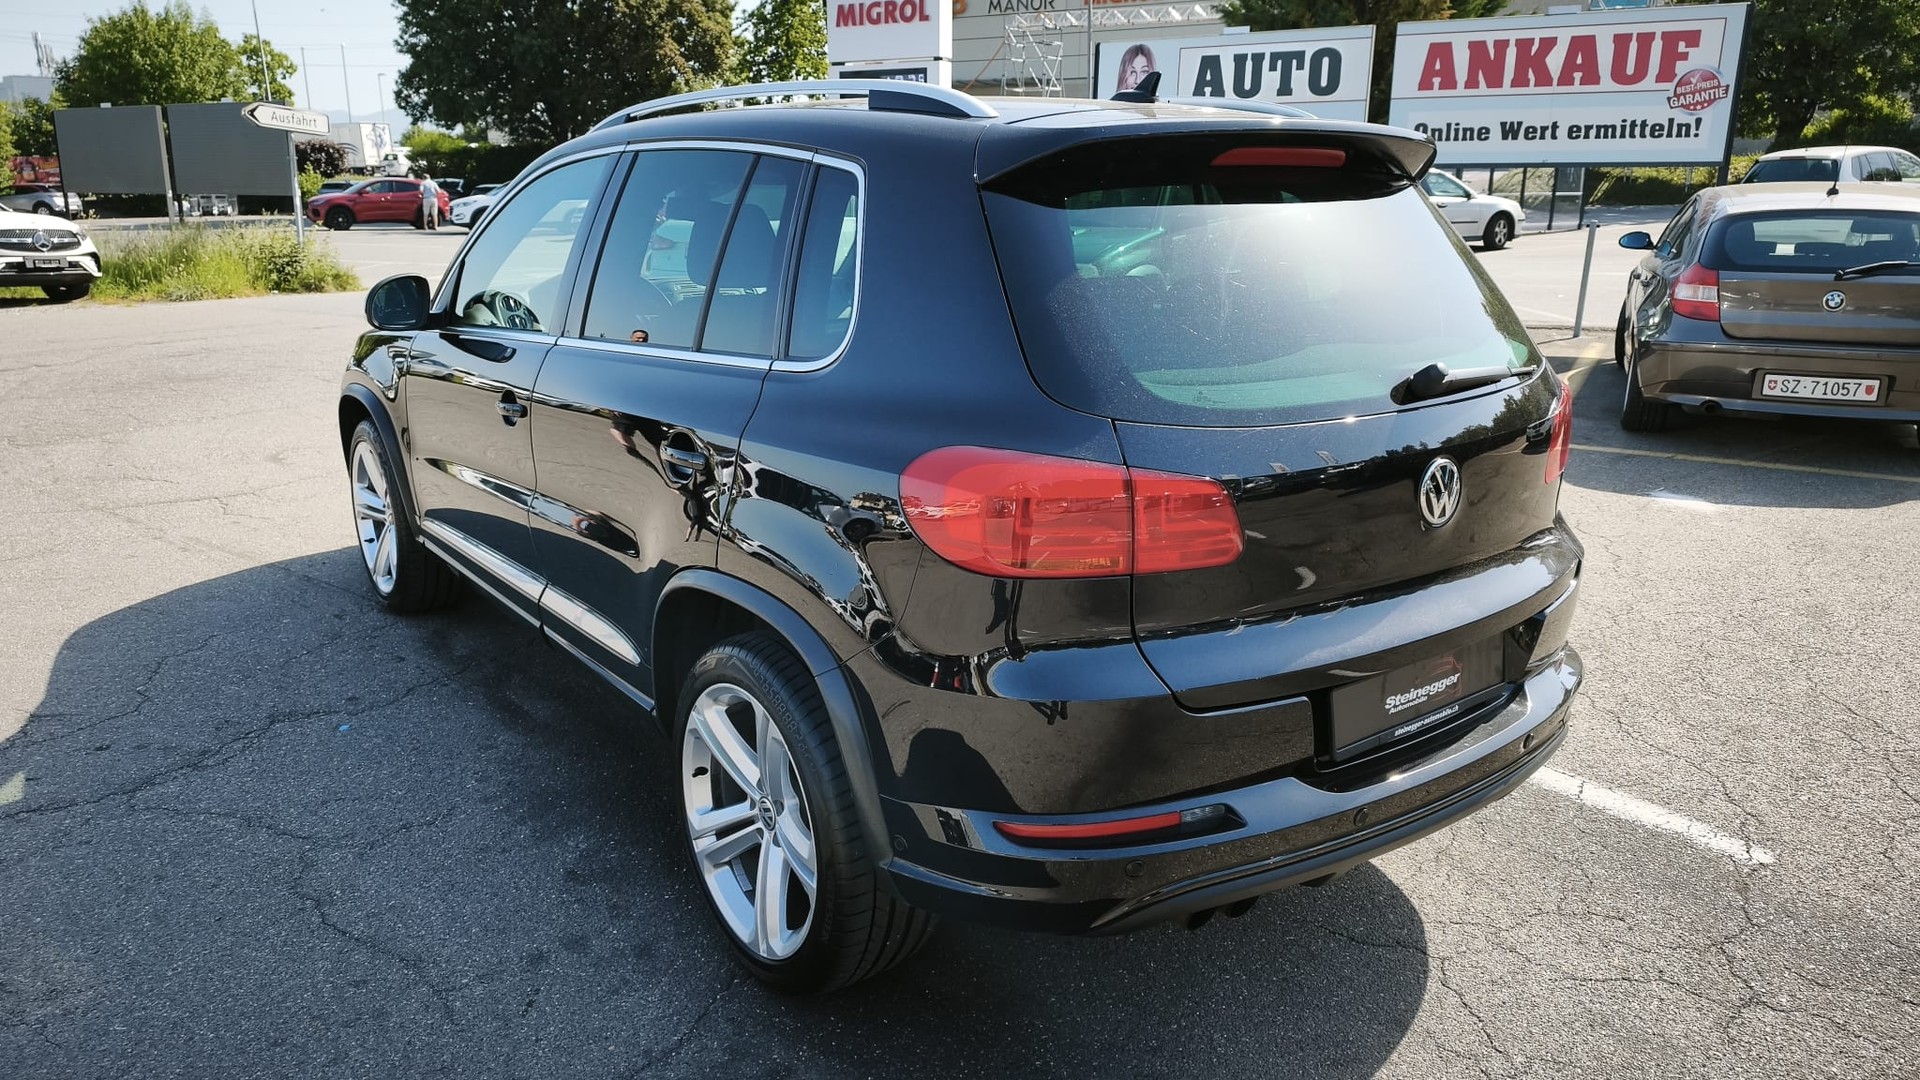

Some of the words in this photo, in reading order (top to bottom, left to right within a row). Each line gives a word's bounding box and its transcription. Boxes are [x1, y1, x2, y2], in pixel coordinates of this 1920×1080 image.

[836, 0, 930, 27] MIGROL
[988, 0, 1055, 14] MANOR
[1417, 29, 1702, 92] ANKAUF
[1192, 47, 1343, 99] AUTO
[1670, 87, 1727, 107] GARANTIE
[1676, 79, 1719, 94] BEST-PREIS
[271, 111, 317, 129] Ausfahrt
[1499, 120, 1560, 141] Wert
[1567, 117, 1703, 140] ermitteln!
[1384, 673, 1461, 709] Steinegger
[1388, 696, 1428, 715] Automobile
